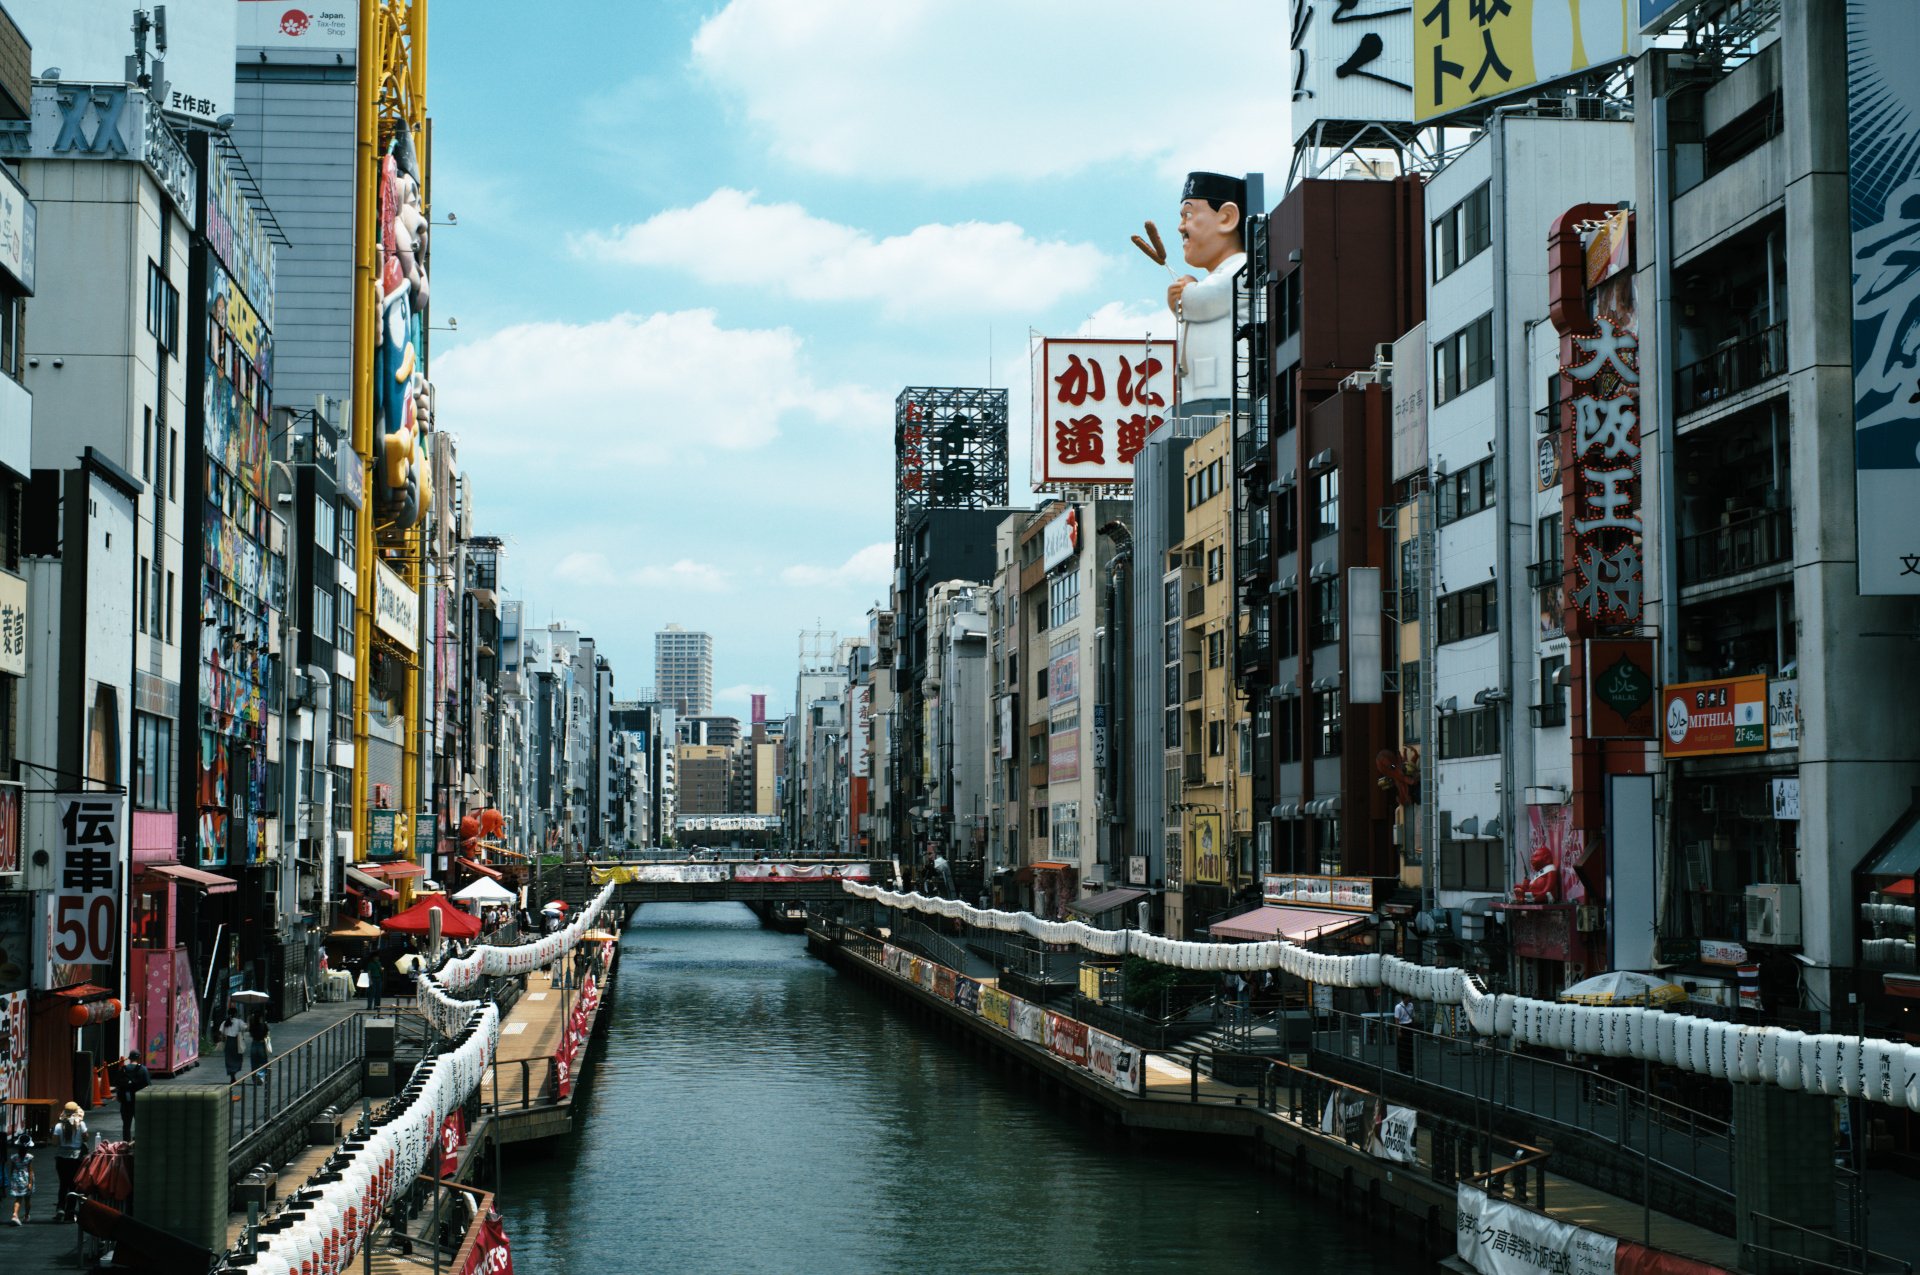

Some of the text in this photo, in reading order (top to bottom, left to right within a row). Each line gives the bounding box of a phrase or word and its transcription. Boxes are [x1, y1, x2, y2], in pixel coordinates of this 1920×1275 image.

[319, 12, 345, 20] Japan.
[327, 28, 345, 36] Shop
[1054, 354, 1165, 407] かに
[903, 401, 925, 492] お好み焼
[1565, 318, 1642, 620] 大阪王将
[1900, 553, 1920, 576] 文
[1688, 711, 1733, 729] MITHILA
[1770, 704, 1794, 726] DING
[1710, 733, 1726, 741] Cuisine
[1735, 728, 1746, 742] 2F
[1095, 728, 1105, 766] いろりや
[374, 815, 393, 835] 薬
[417, 820, 434, 836] 薬
[62, 801, 115, 894] 伝串
[55, 895, 115, 962] 50
